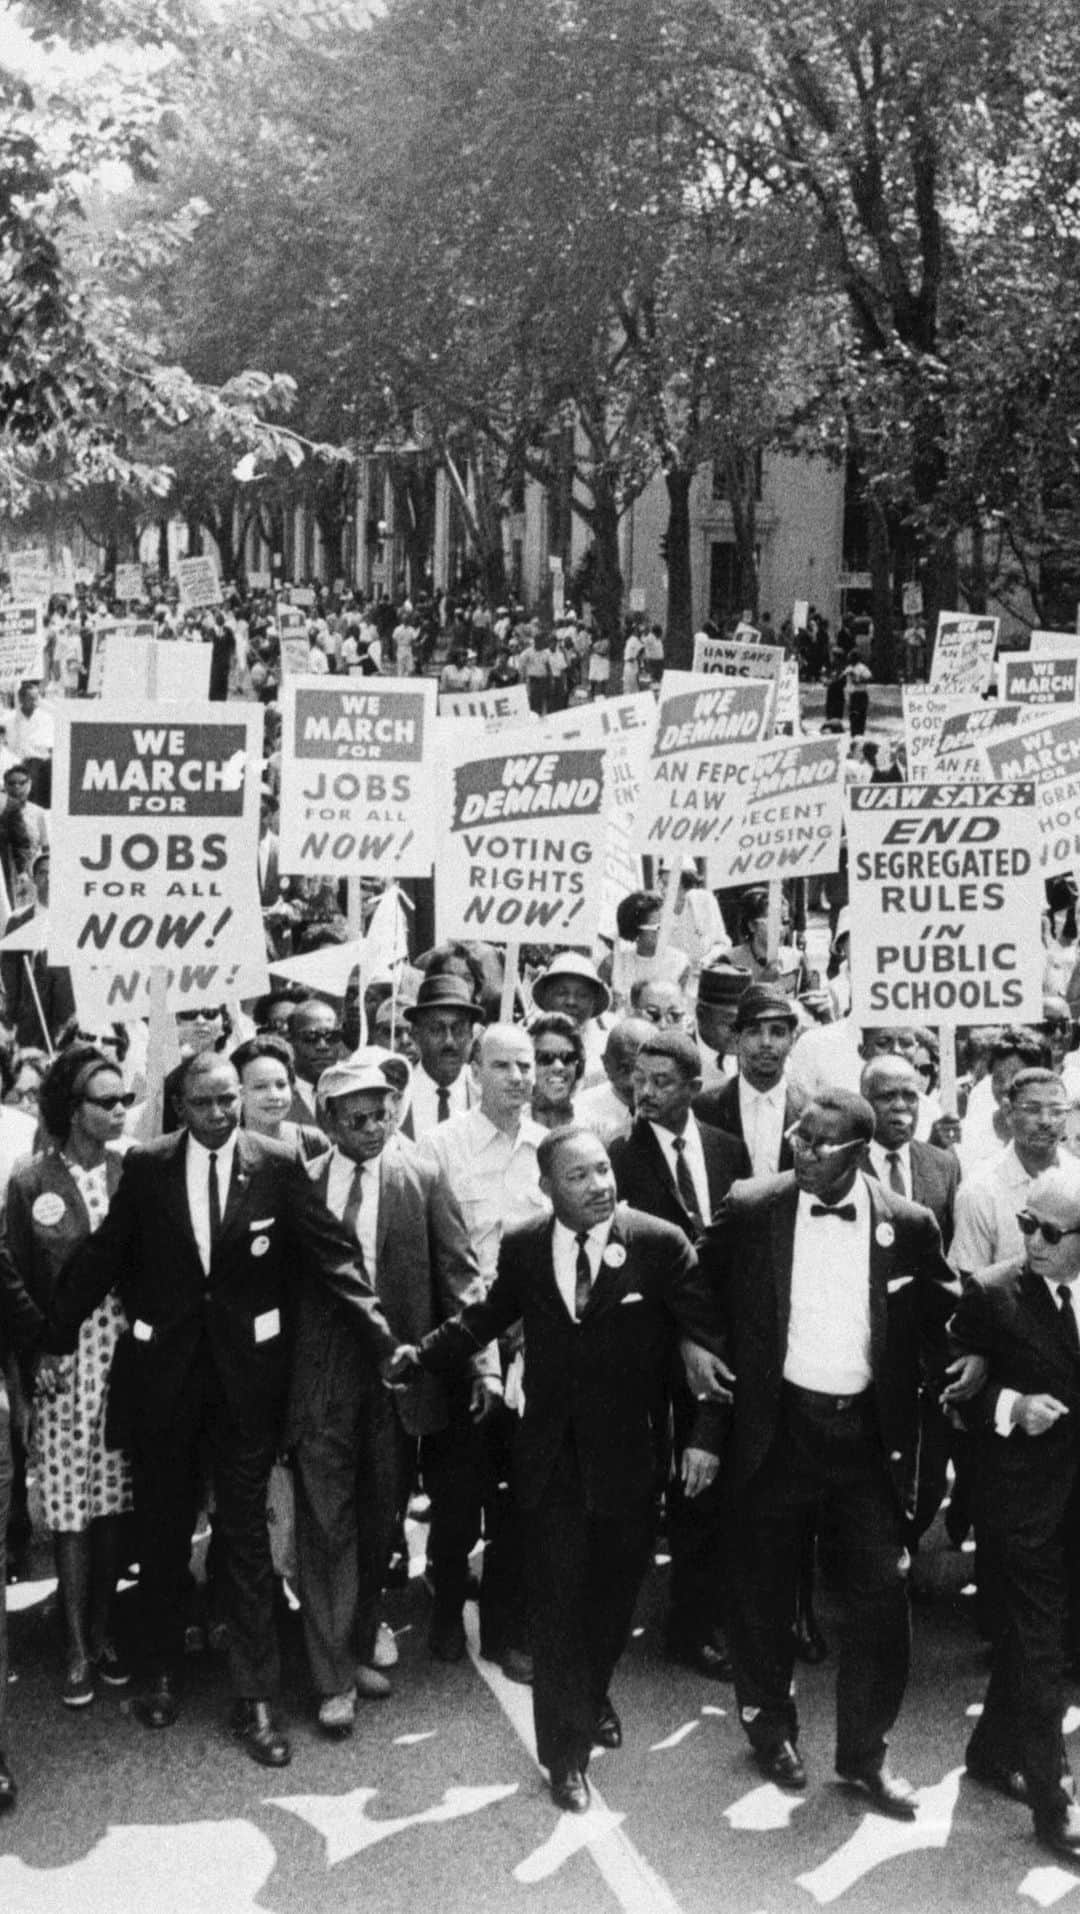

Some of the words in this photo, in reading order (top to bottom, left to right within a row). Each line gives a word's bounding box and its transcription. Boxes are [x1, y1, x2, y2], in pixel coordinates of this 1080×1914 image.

[703, 646, 738, 660] UAW
[1032, 662, 1055, 676] WE
[1009, 675, 1074, 695] MARCH
[341, 695, 380, 716] WE
[693, 689, 737, 718] WE
[303, 716, 415, 744] MARCH
[659, 709, 760, 751] DEMAND
[966, 709, 998, 732] WE
[132, 729, 185, 756] WE
[337, 745, 381, 758] FOR
[1020, 729, 1055, 751] WE
[81, 759, 236, 792] MARCH
[501, 753, 559, 787] WE
[654, 761, 689, 783] AN
[696, 761, 750, 785] FEPC
[755, 759, 837, 798] MAND
[935, 758, 960, 772] AN
[303, 773, 411, 802] JOBS
[460, 777, 600, 824] DEMAND
[670, 789, 726, 811] LAW
[857, 786, 928, 809] UAW
[931, 783, 1032, 808] SAYS:
[128, 796, 187, 812] FOR
[305, 808, 351, 821] FOR
[366, 809, 407, 822] ALL
[741, 802, 827, 826] ECENT
[648, 815, 734, 843] NOW!
[738, 824, 833, 850] OUSING
[881, 816, 1001, 846] END
[79, 833, 228, 872] JOBS
[301, 829, 415, 861] NOW!
[462, 834, 593, 865] VOTING
[728, 841, 828, 876] NOW!
[856, 848, 1032, 881] SEGREGATED
[84, 881, 147, 897] FOR
[166, 881, 222, 897] ALL
[469, 865, 584, 895] RIGHTS
[463, 895, 585, 928] NOW!
[881, 883, 1005, 913] RULES
[76, 906, 233, 950] NOW!
[920, 924, 965, 940] IN
[876, 943, 1017, 974] PUBLIC
[870, 979, 1024, 1011] SCHOOLS
